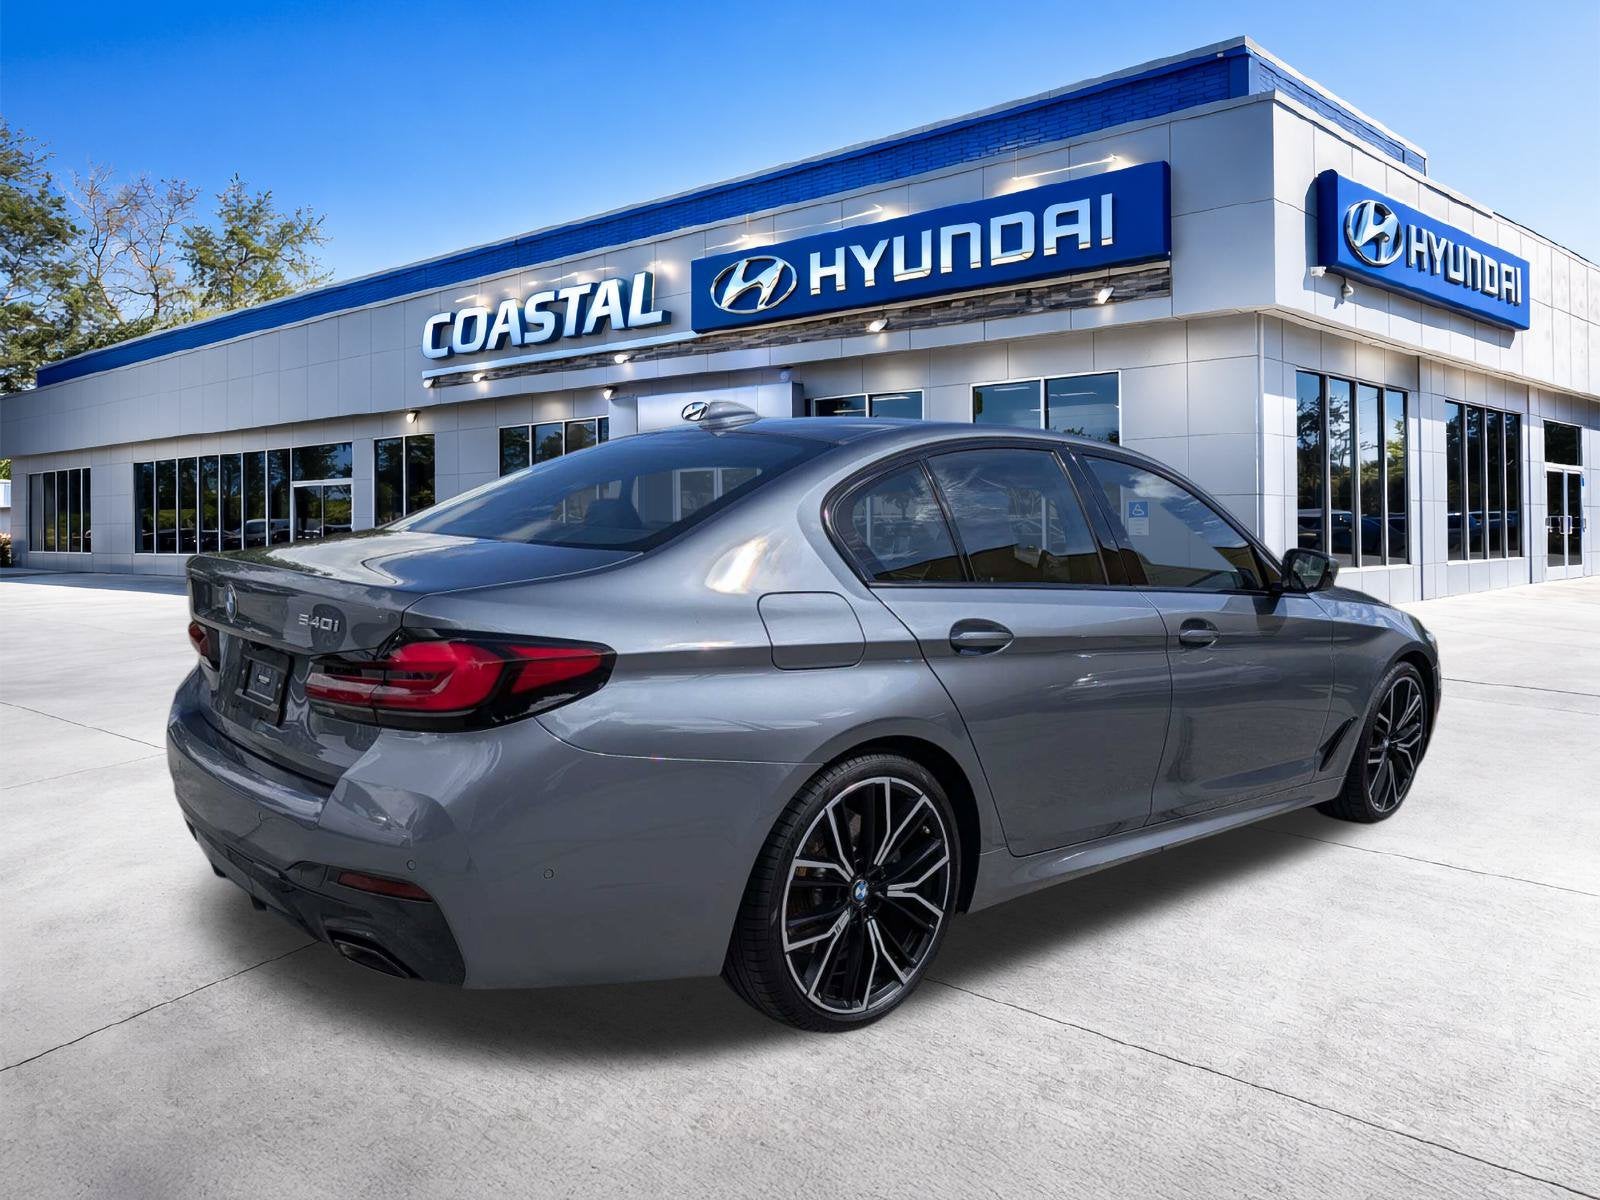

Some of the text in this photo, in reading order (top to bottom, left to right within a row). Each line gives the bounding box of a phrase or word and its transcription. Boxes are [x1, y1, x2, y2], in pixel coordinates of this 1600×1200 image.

[809, 192, 1114, 296] HYUNDAI
[1406, 224, 1522, 307] HYUNDAI
[422, 271, 668, 359] COASTAL
